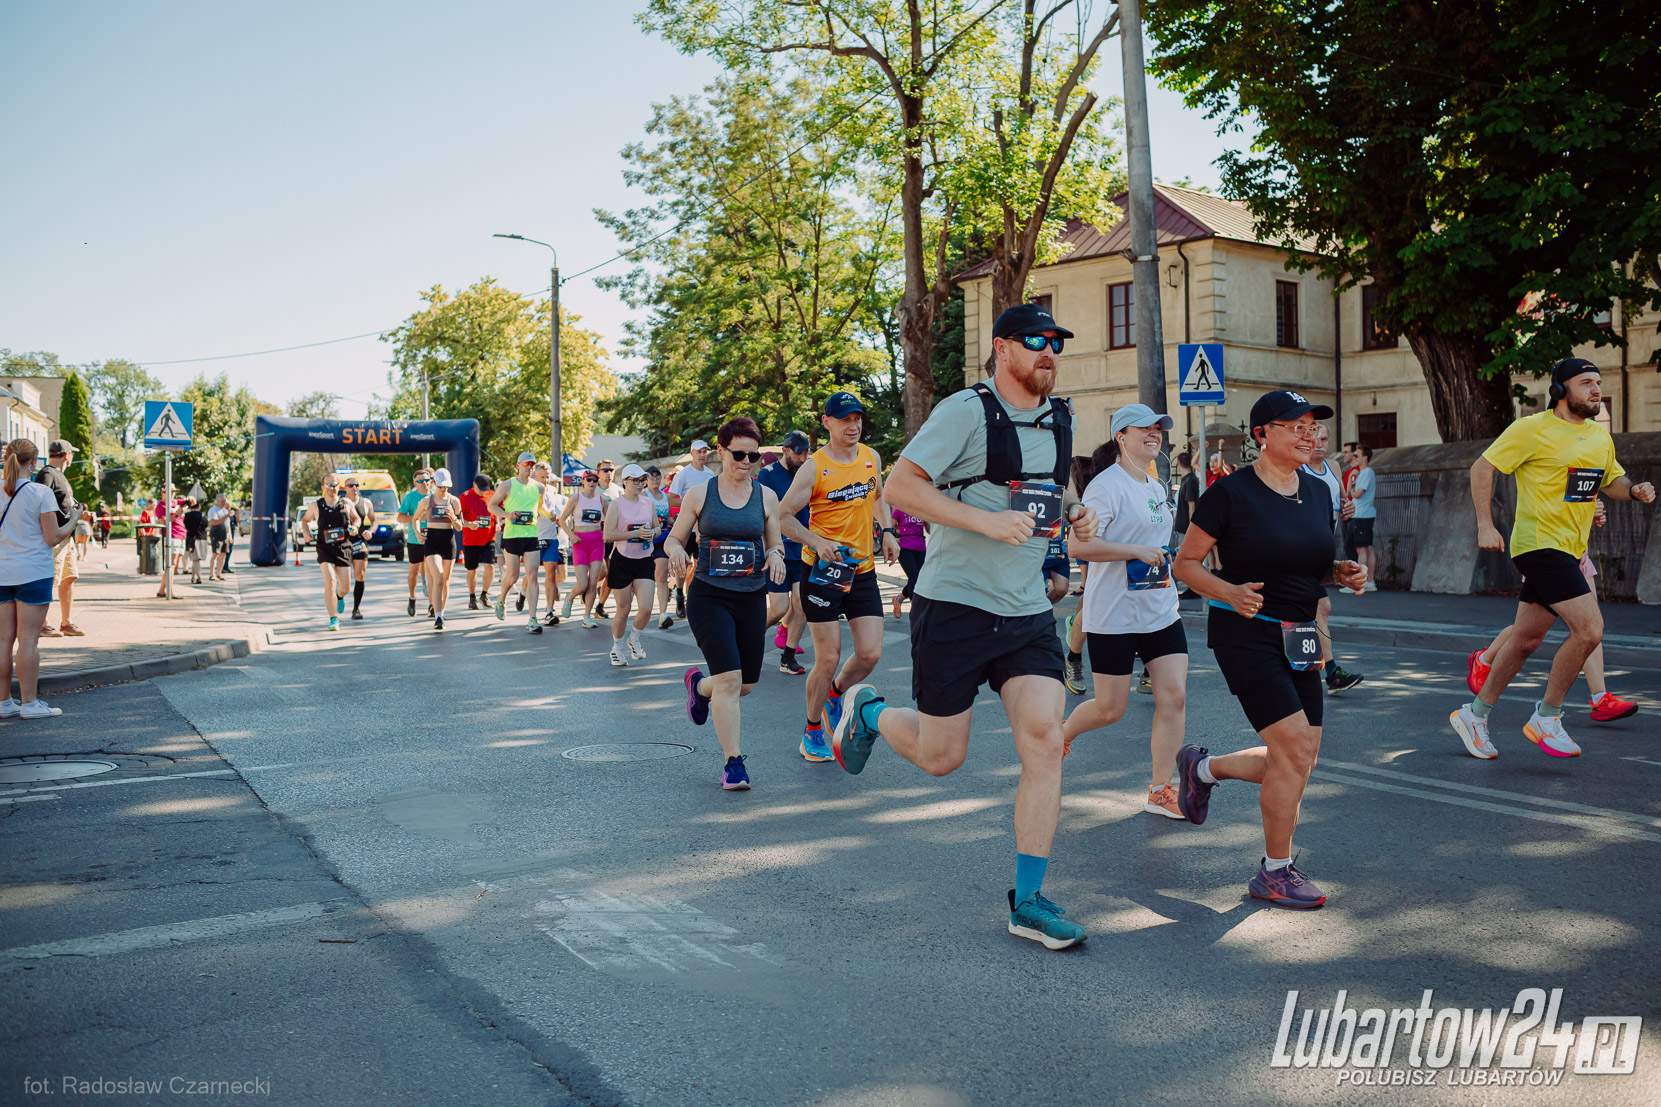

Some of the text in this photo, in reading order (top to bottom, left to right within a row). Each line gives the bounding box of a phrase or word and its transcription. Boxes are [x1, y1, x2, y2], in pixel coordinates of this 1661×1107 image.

[342, 428, 403, 444] START
[1577, 481, 1595, 491] 107
[1028, 502, 1046, 519] 92
[721, 554, 744, 565] 134
[826, 567, 841, 579] 20
[1302, 639, 1316, 654] 80
